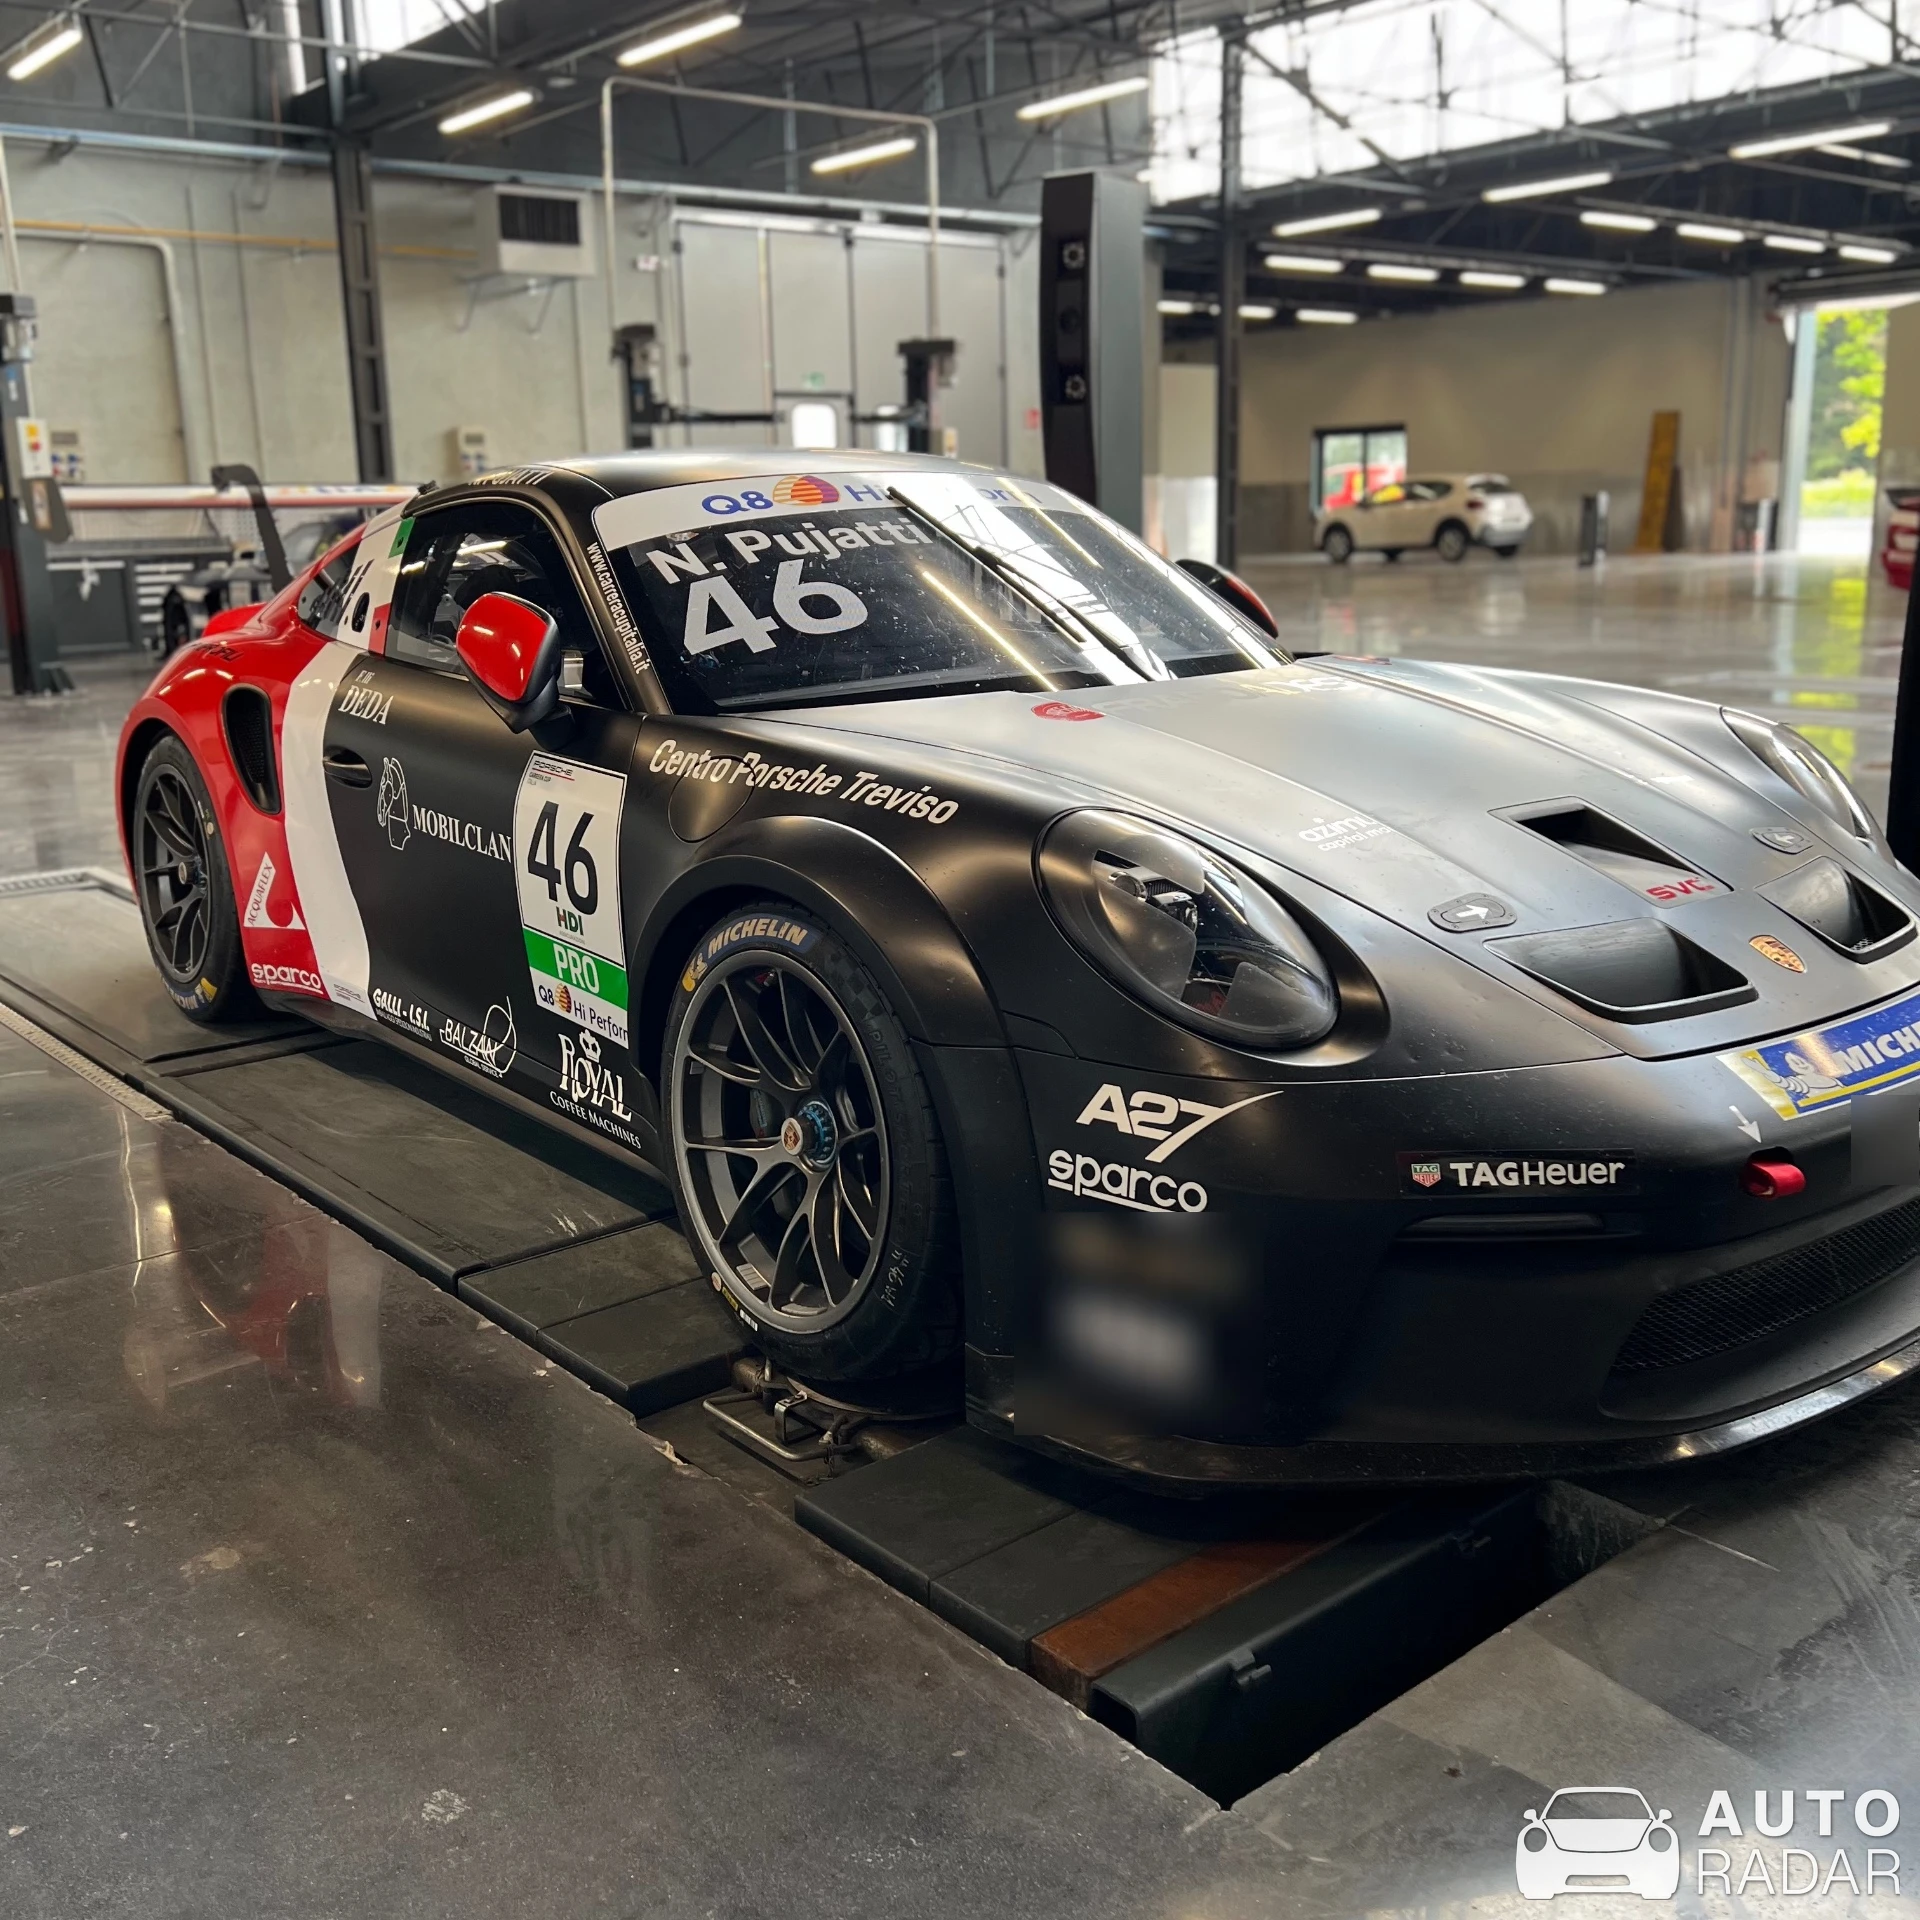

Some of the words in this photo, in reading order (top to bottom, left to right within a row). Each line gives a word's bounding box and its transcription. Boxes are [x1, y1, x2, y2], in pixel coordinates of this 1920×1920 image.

[701, 489, 774, 515] Q8
[646, 543, 726, 585] N.
[725, 517, 936, 563] Pujatti
[587, 541, 650, 674] www.carreracupitalia.it
[683, 559, 868, 656] 46
[338, 685, 394, 725] DEDA
[533, 760, 574, 777] PORSCHE
[649, 739, 732, 782] Centro
[728, 752, 842, 795] Porsche
[839, 771, 959, 825] Treviso
[412, 804, 512, 864] MOBILCLAN
[528, 800, 598, 915] 46
[1318, 831, 1368, 851] capital
[247, 863, 273, 926] ACQUAFLEX
[555, 906, 585, 936] HDI
[707, 918, 808, 959] MICHELIN
[251, 963, 322, 989] sparco
[553, 942, 600, 994] PRO
[372, 987, 402, 1017] GALLI
[538, 984, 555, 1006] Q8
[573, 1002, 587, 1021] Hi
[558, 1033, 632, 1122] ROYAL
[549, 1091, 587, 1121] COFFEE
[588, 1109, 642, 1149] MACHINES
[1076, 1083, 1285, 1163] A27
[1048, 1149, 1208, 1213] sparco
[1412, 1173, 1441, 1184] HEUER
[1413, 1165, 1439, 1173] TAG
